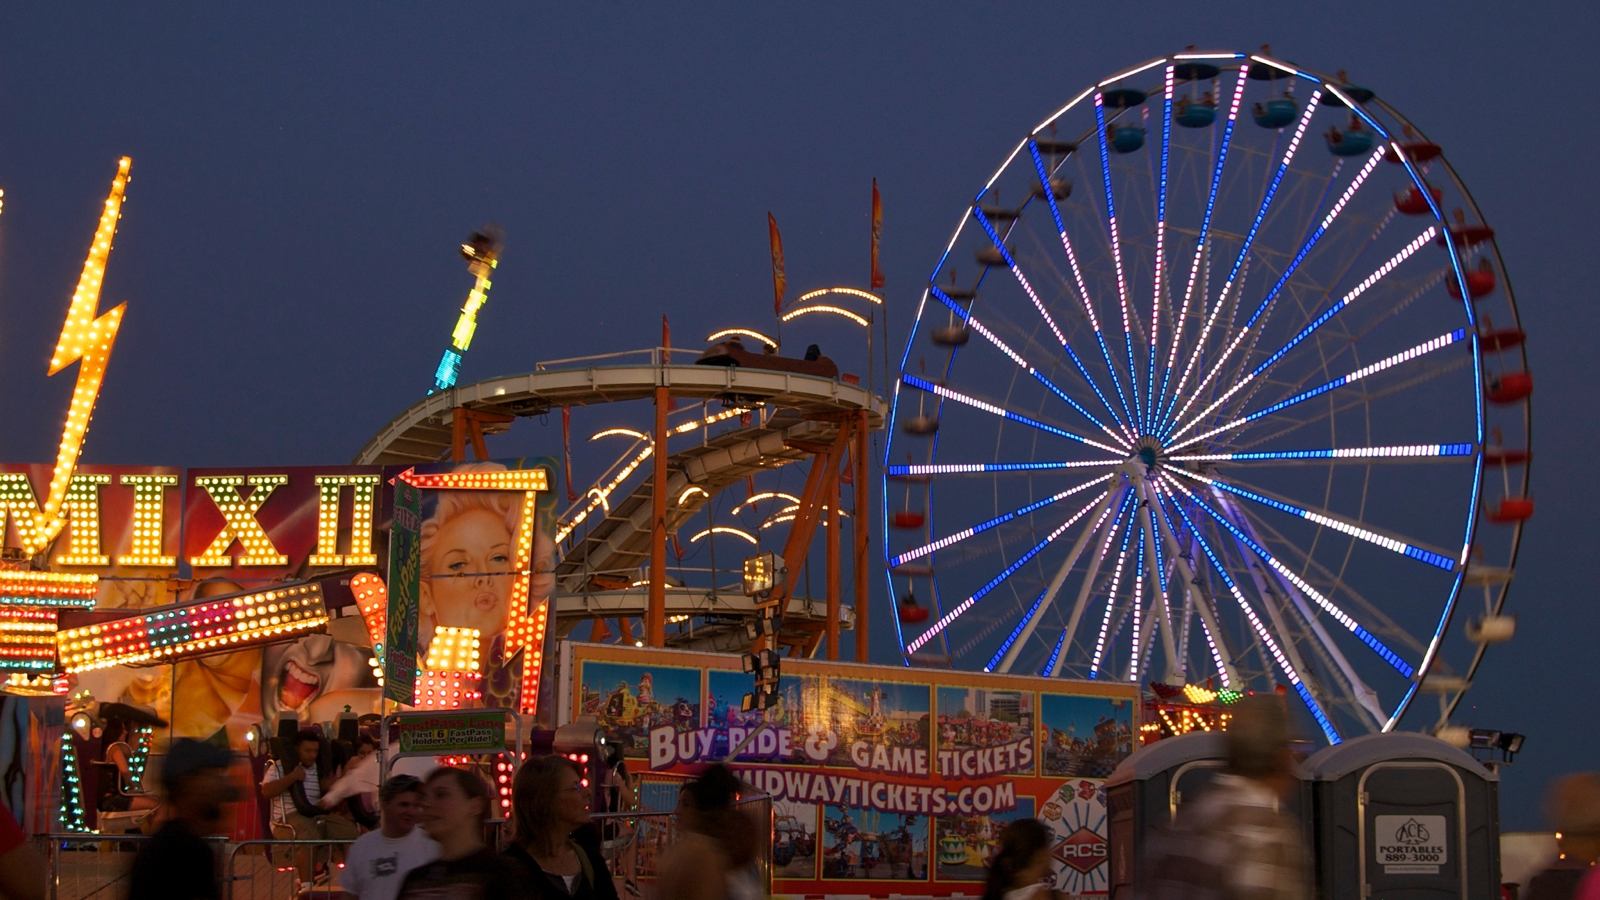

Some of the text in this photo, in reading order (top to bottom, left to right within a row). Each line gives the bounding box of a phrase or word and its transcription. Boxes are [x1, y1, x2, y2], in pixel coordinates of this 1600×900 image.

[0, 473, 381, 566] MIX II
[390, 533, 420, 646] FastPass
[399, 717, 503, 733] FastPass Lane
[411, 729, 492, 739] First 6 FastPass
[467, 735, 492, 743] Ride!
[727, 726, 793, 757] RIDE
[804, 728, 838, 761] &
[851, 740, 930, 775] GAME
[938, 737, 1033, 777] TICKETS
[1396, 823, 1428, 843] ACE
[1063, 843, 1107, 858] RCS
[1379, 846, 1444, 854] PORTABLES
[1385, 854, 1440, 862] 889-3000
